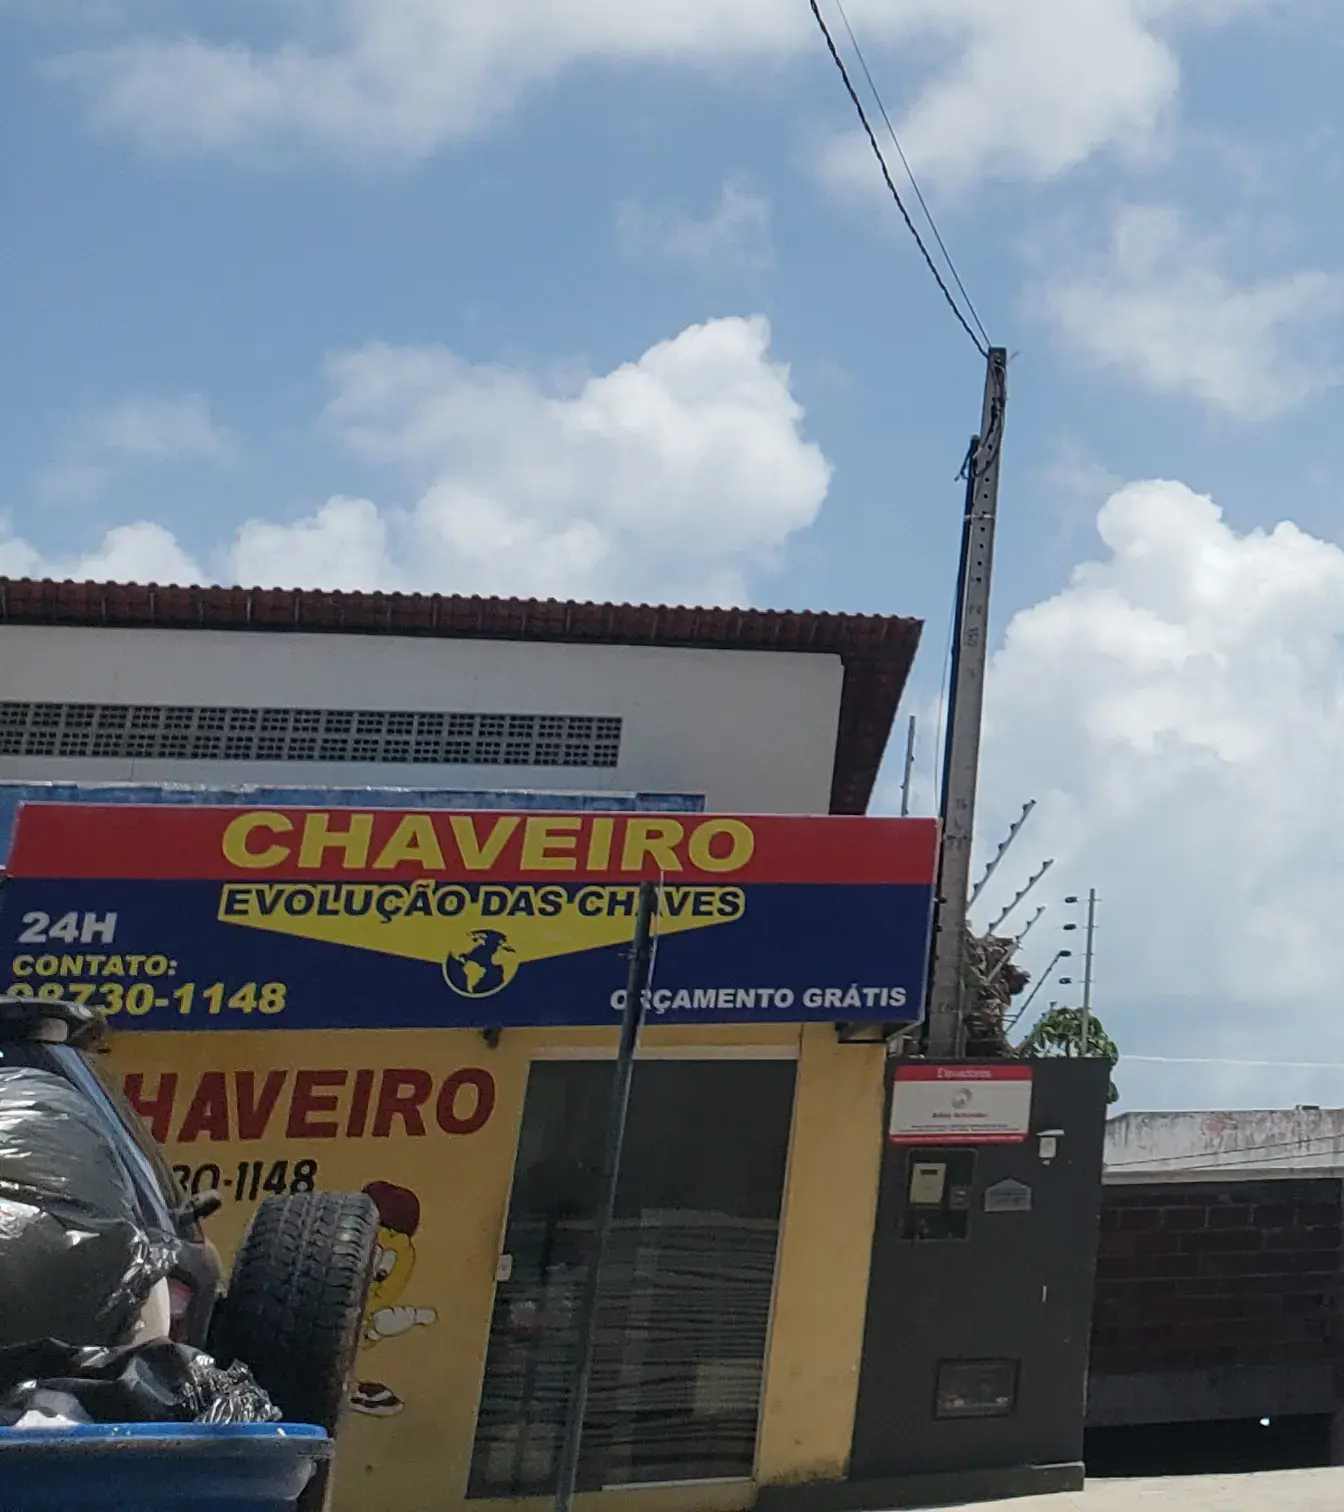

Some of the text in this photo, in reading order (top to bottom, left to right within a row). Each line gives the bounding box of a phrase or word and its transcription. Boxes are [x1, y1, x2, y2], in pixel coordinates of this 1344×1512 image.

[221, 811, 755, 873] CHAVEIRO
[222, 881, 741, 924] EVOLUÇÃO DAS CHVES
[18, 911, 118, 943] 24H
[12, 954, 178, 976] CONTATO:
[802, 984, 907, 1007] GRÁTIS
